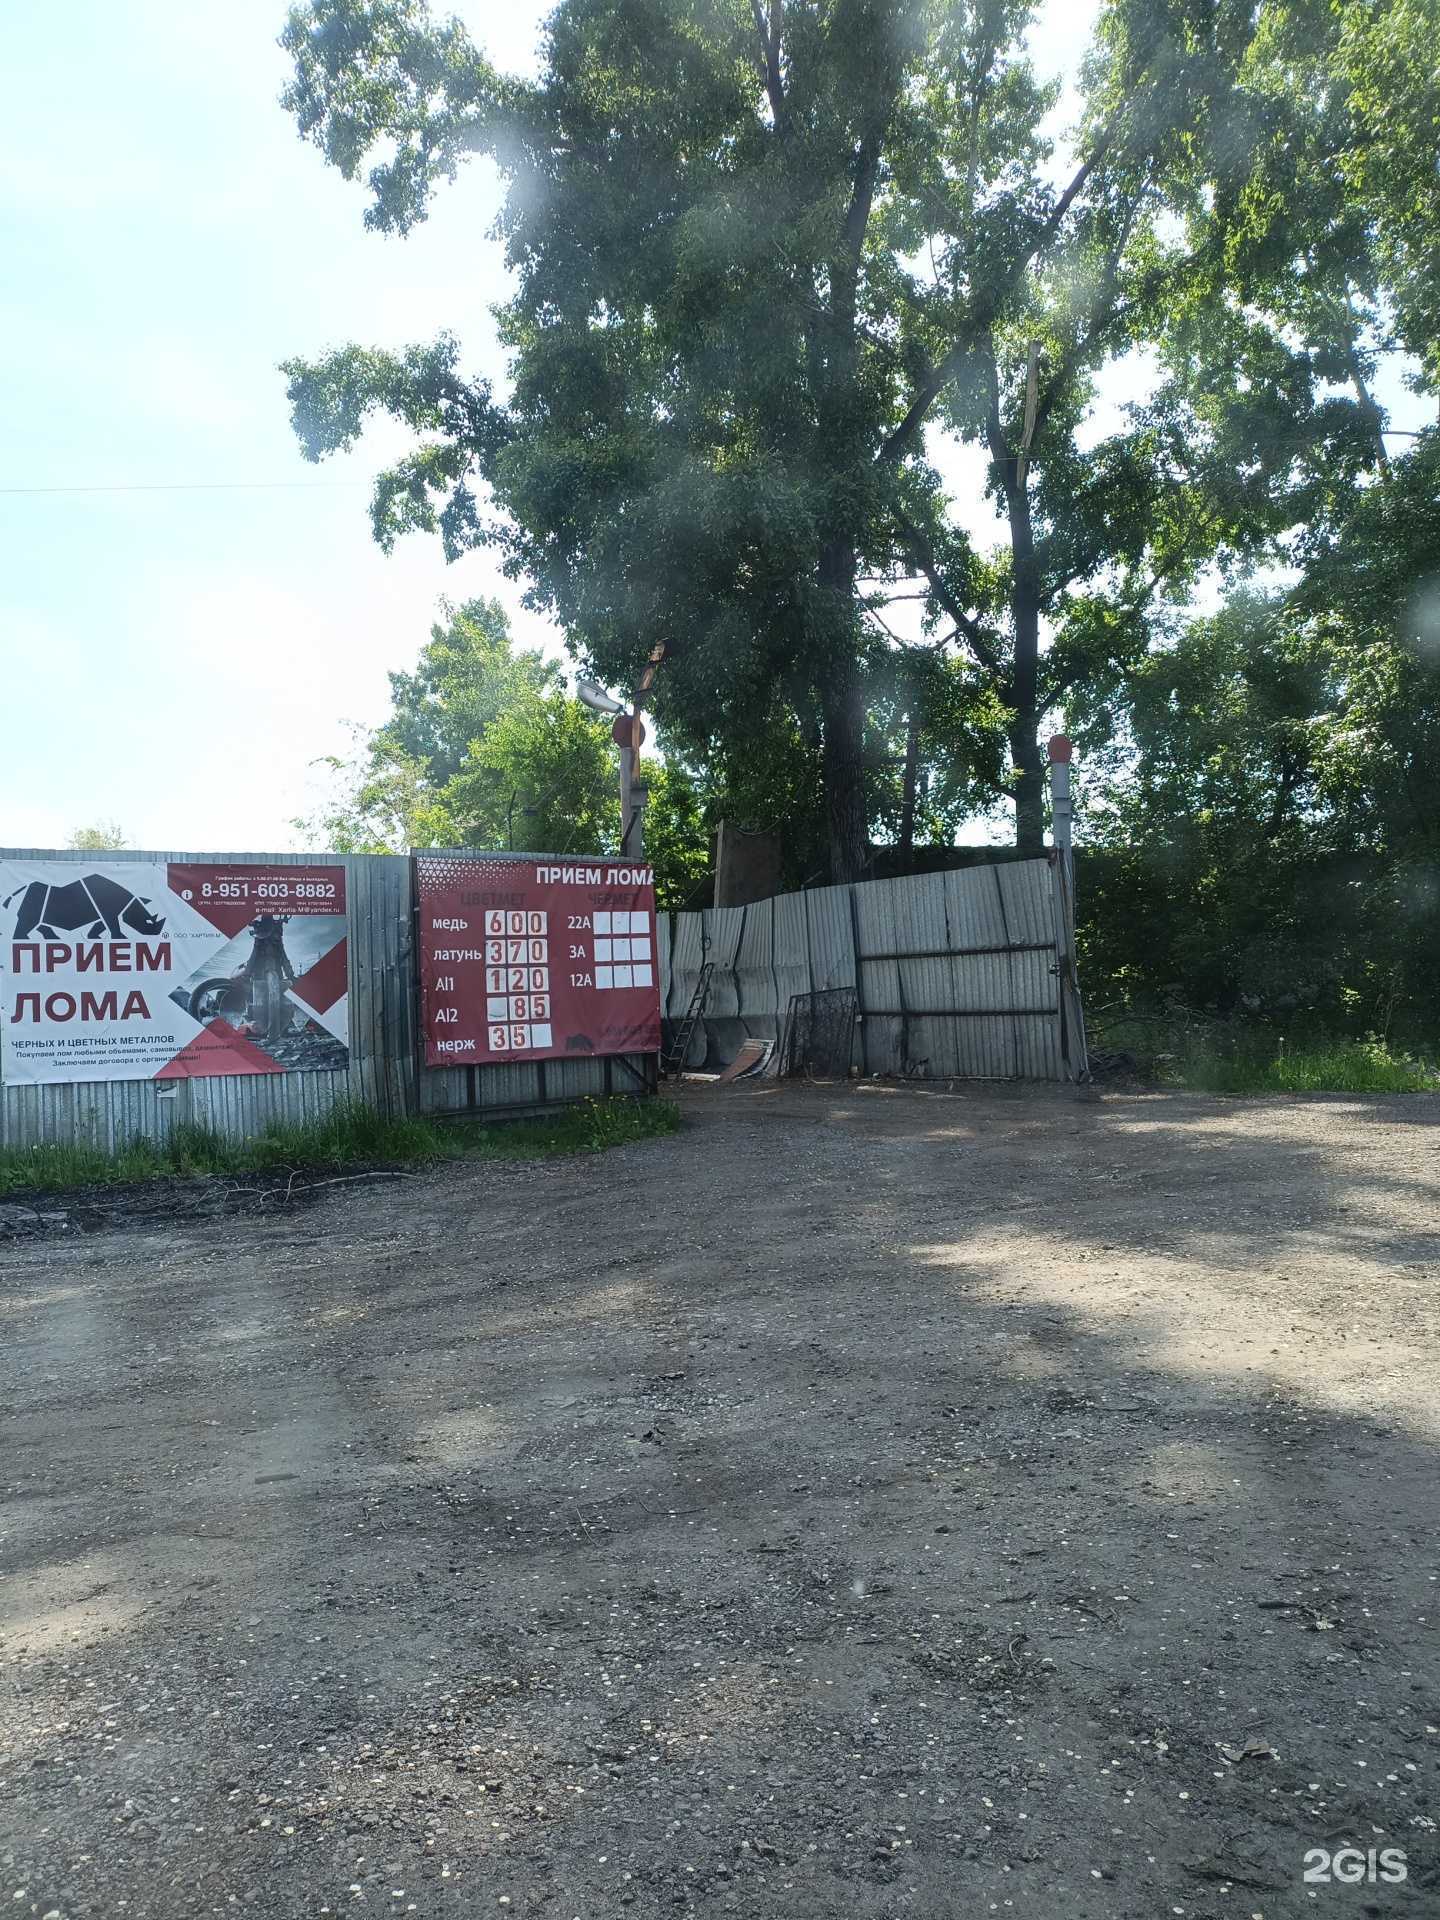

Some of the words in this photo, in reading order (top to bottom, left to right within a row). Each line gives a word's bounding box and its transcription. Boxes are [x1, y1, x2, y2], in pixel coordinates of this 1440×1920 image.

[536, 866, 601, 885] ПРИЕМ
[201, 883, 336, 898] 8-951-603-8882
[432, 917, 468, 931] медь
[489, 911, 543, 934] 600
[11, 942, 172, 973] ПРИЕМ
[433, 947, 482, 962] латунь
[490, 940, 542, 964] 370
[491, 968, 544, 992] 120
[10, 990, 152, 1024] ЛОМА
[514, 997, 546, 1019] 85
[11, 1040, 55, 1048] ЧЕРНЫХ
[68, 1038, 117, 1047] ЦВЕТНЫХ
[120, 1035, 175, 1045] МЕТАЛЛОВ
[437, 1038, 476, 1053] нерж
[492, 1025, 526, 1049] 35
